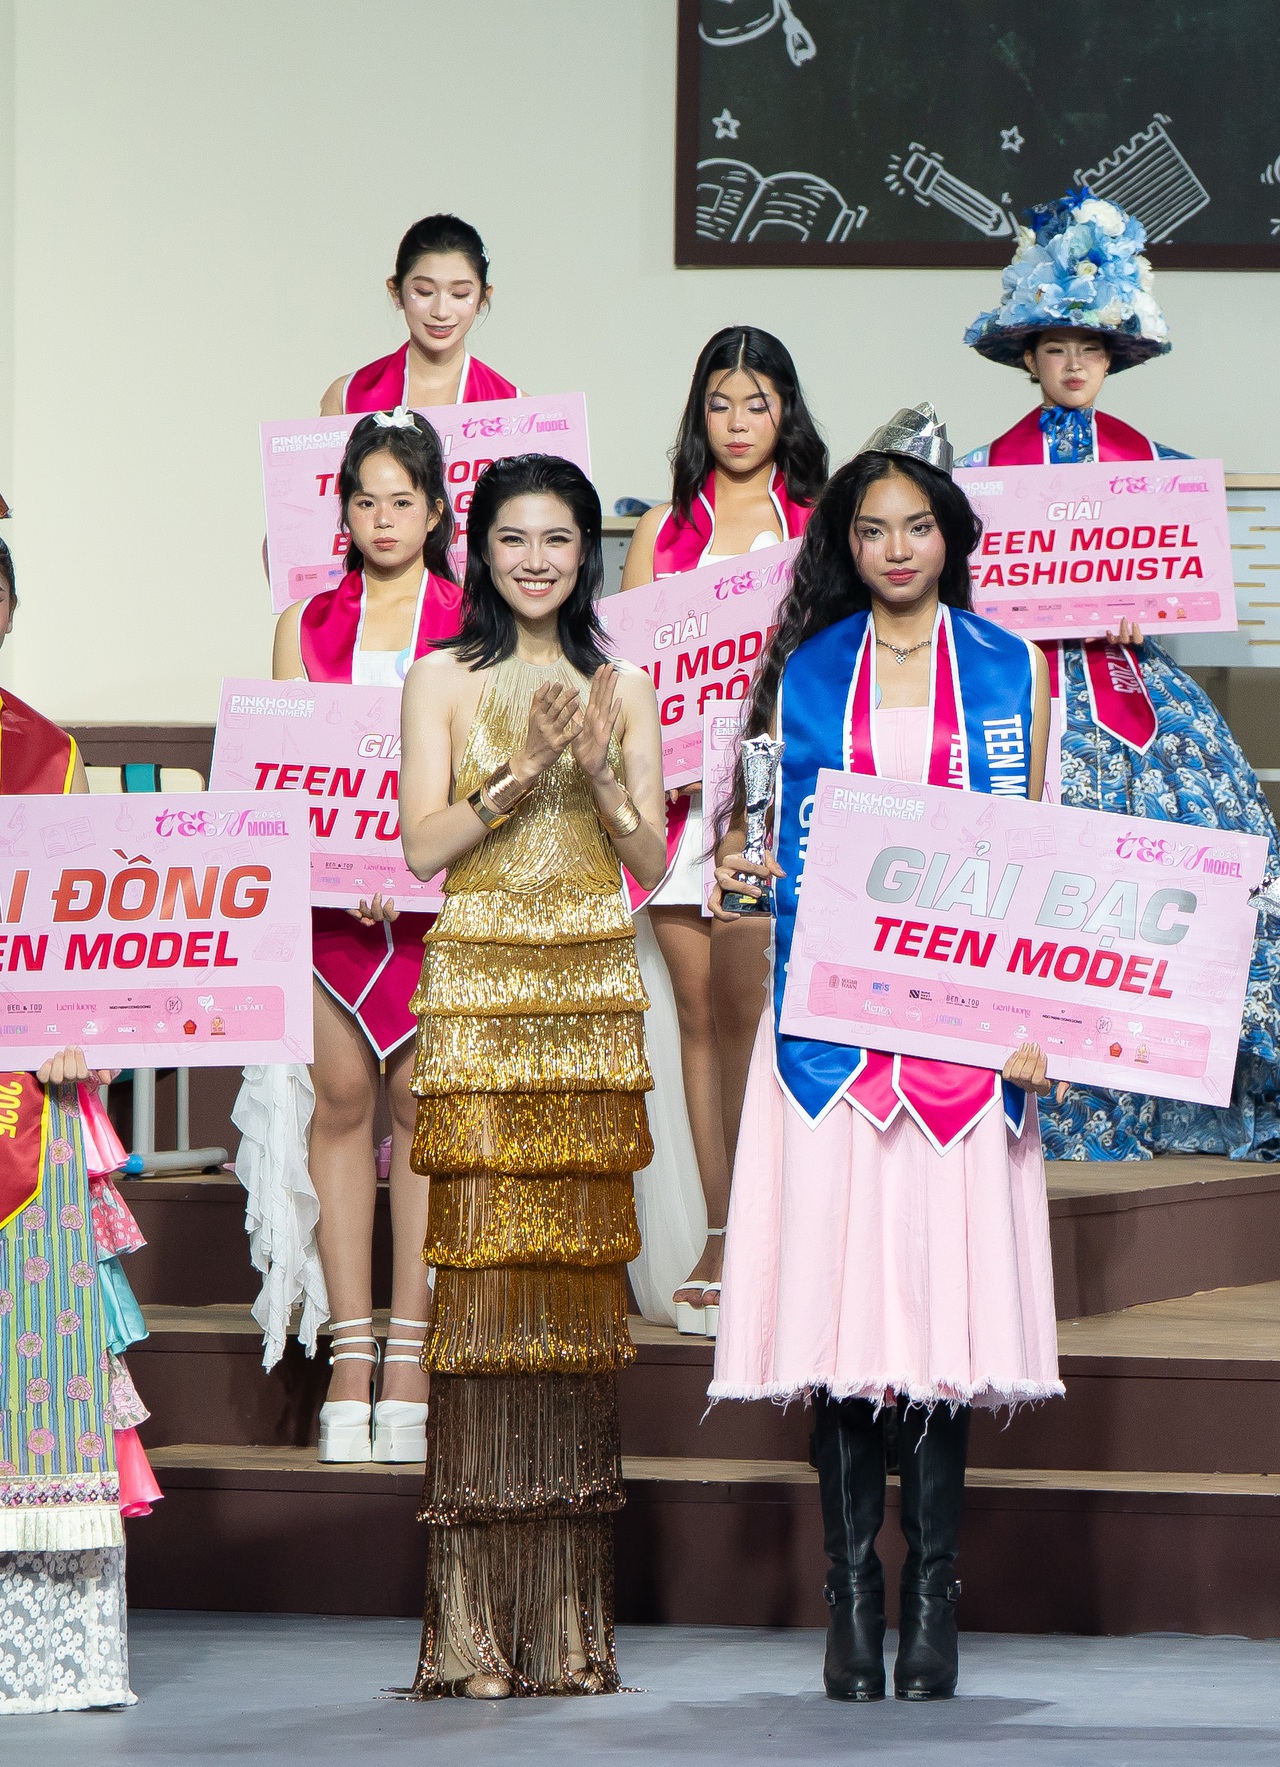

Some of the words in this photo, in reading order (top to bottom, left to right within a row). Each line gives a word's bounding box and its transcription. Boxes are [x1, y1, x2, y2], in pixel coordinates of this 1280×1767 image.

[271, 431, 348, 447] PINKHOUSE
[1047, 495, 1104, 521] GIẢI
[981, 529, 1056, 556] EEN
[1069, 523, 1199, 552] MODEL
[653, 610, 710, 651] GIẢI
[229, 706, 314, 719] ENTERTAINMENT
[231, 695, 315, 711] PINKHOUSE
[982, 714, 1026, 769] TEEN
[831, 800, 923, 823] ENTERTAINMENT
[833, 787, 925, 814] PINKHOUSE
[247, 821, 289, 837] MODEL
[1203, 859, 1243, 879] MODEL
[51, 848, 272, 923] ĐỒNG
[865, 840, 1024, 921] GIẢI
[1034, 869, 1199, 948] BẠC
[64, 930, 239, 972] MODEL
[873, 915, 996, 969] TEEN
[1005, 937, 1176, 1000] MODEL
